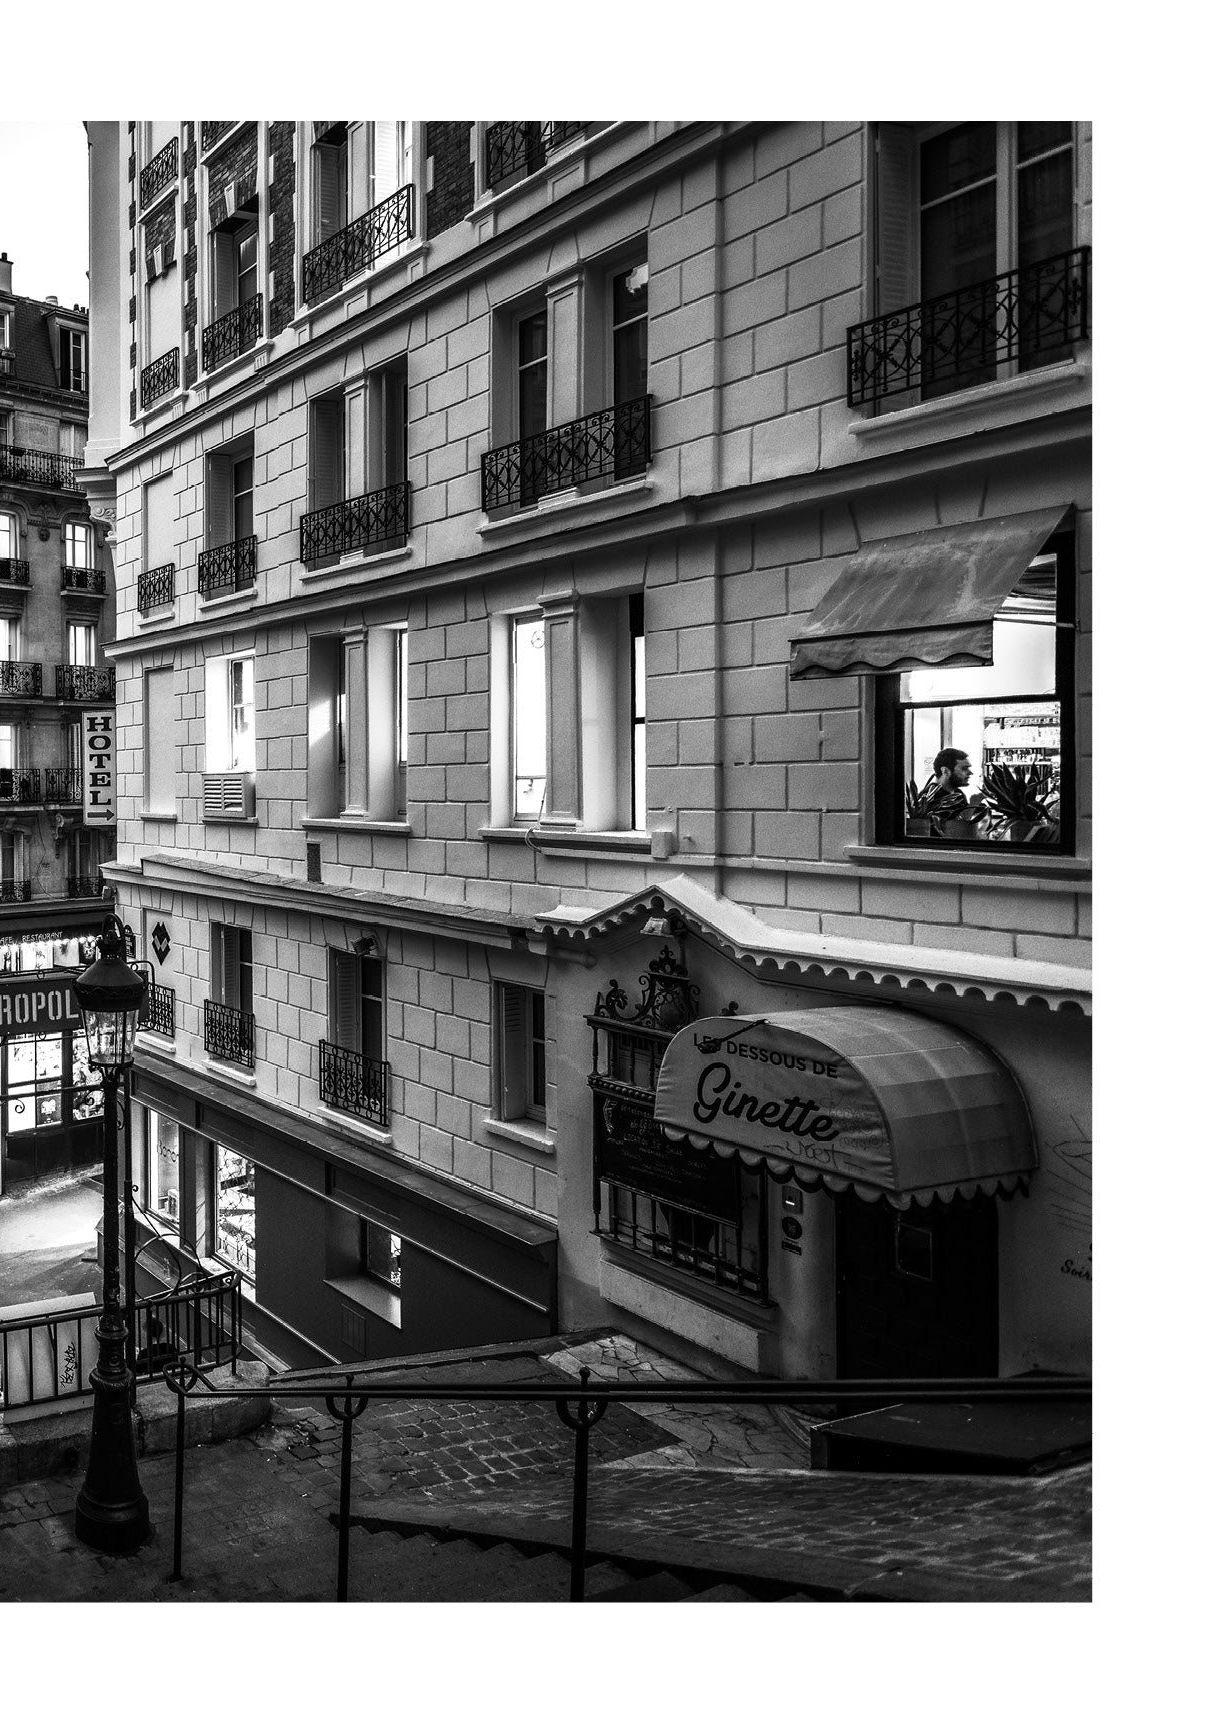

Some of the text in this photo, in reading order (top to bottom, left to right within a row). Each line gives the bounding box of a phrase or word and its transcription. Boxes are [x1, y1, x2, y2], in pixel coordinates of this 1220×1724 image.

[86, 716, 113, 806] HOTEL
[21, 931, 63, 943] RESTAURANT
[726, 1041, 807, 1072] DESSOUS
[813, 1060, 838, 1079] DE
[693, 1062, 840, 1142] Ginette
[1060, 1259, 1092, 1281] Soir
